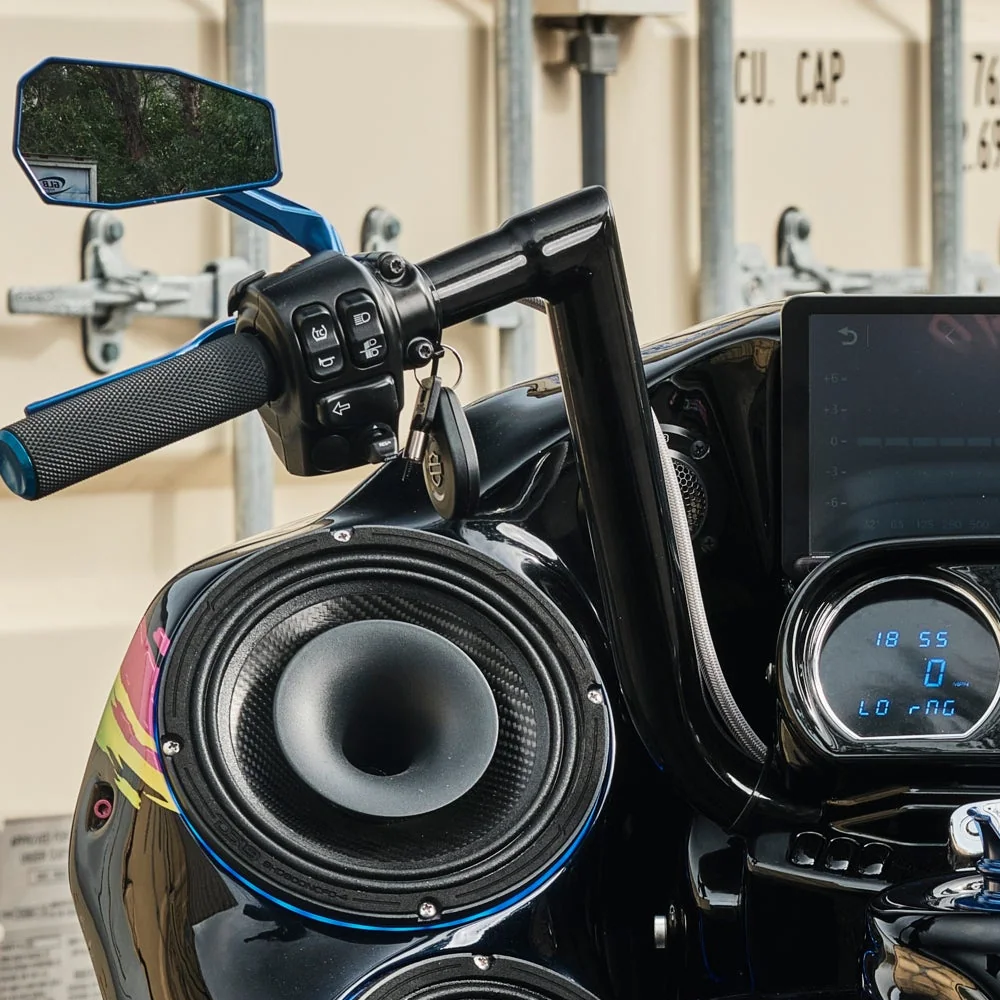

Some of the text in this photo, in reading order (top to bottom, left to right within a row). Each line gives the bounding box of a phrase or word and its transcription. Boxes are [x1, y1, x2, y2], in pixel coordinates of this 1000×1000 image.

[734, 50, 849, 106] CU. CAP.
[923, 658, 946, 688] 0
